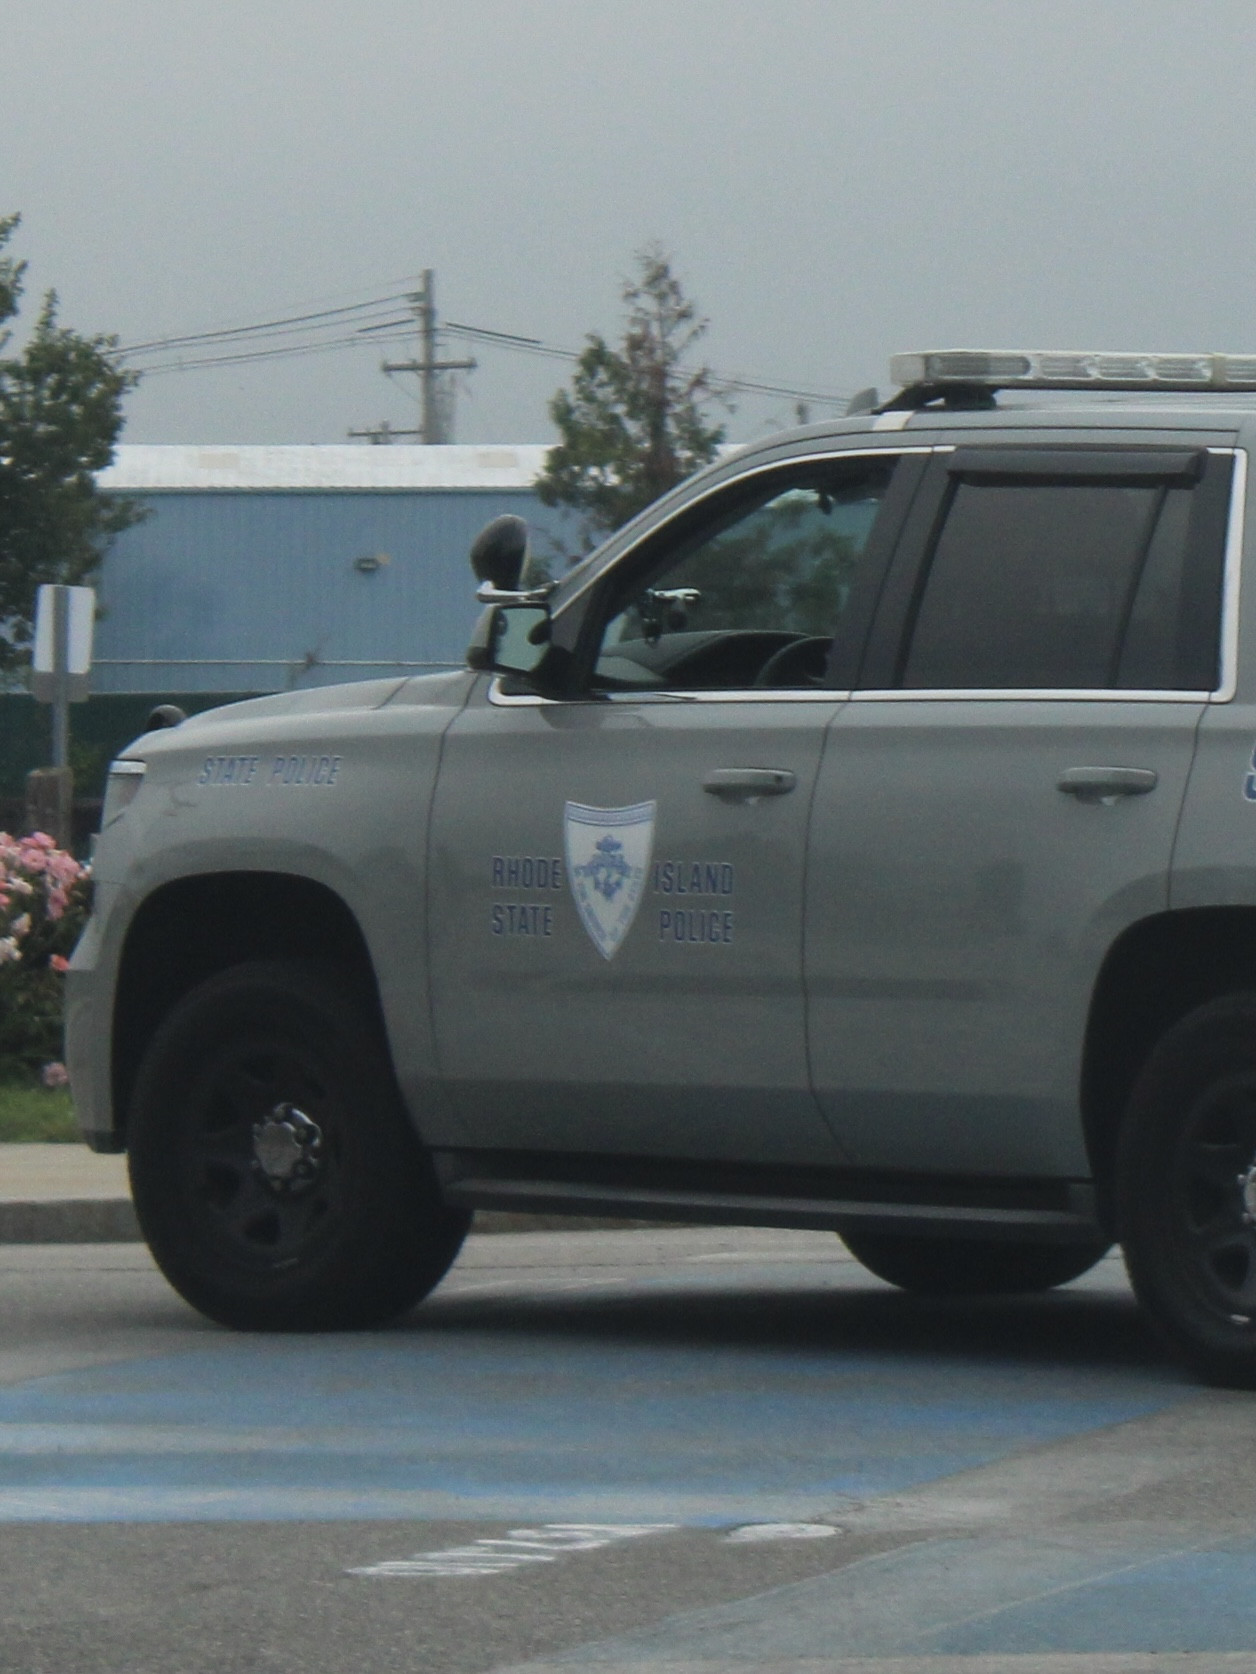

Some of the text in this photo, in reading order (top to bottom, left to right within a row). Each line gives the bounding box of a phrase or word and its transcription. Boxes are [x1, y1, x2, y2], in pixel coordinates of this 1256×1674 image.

[197, 755, 343, 786] STATE POLICE
[492, 856, 735, 896] RHODE ISLAND
[492, 903, 735, 944] STATE POLICE
